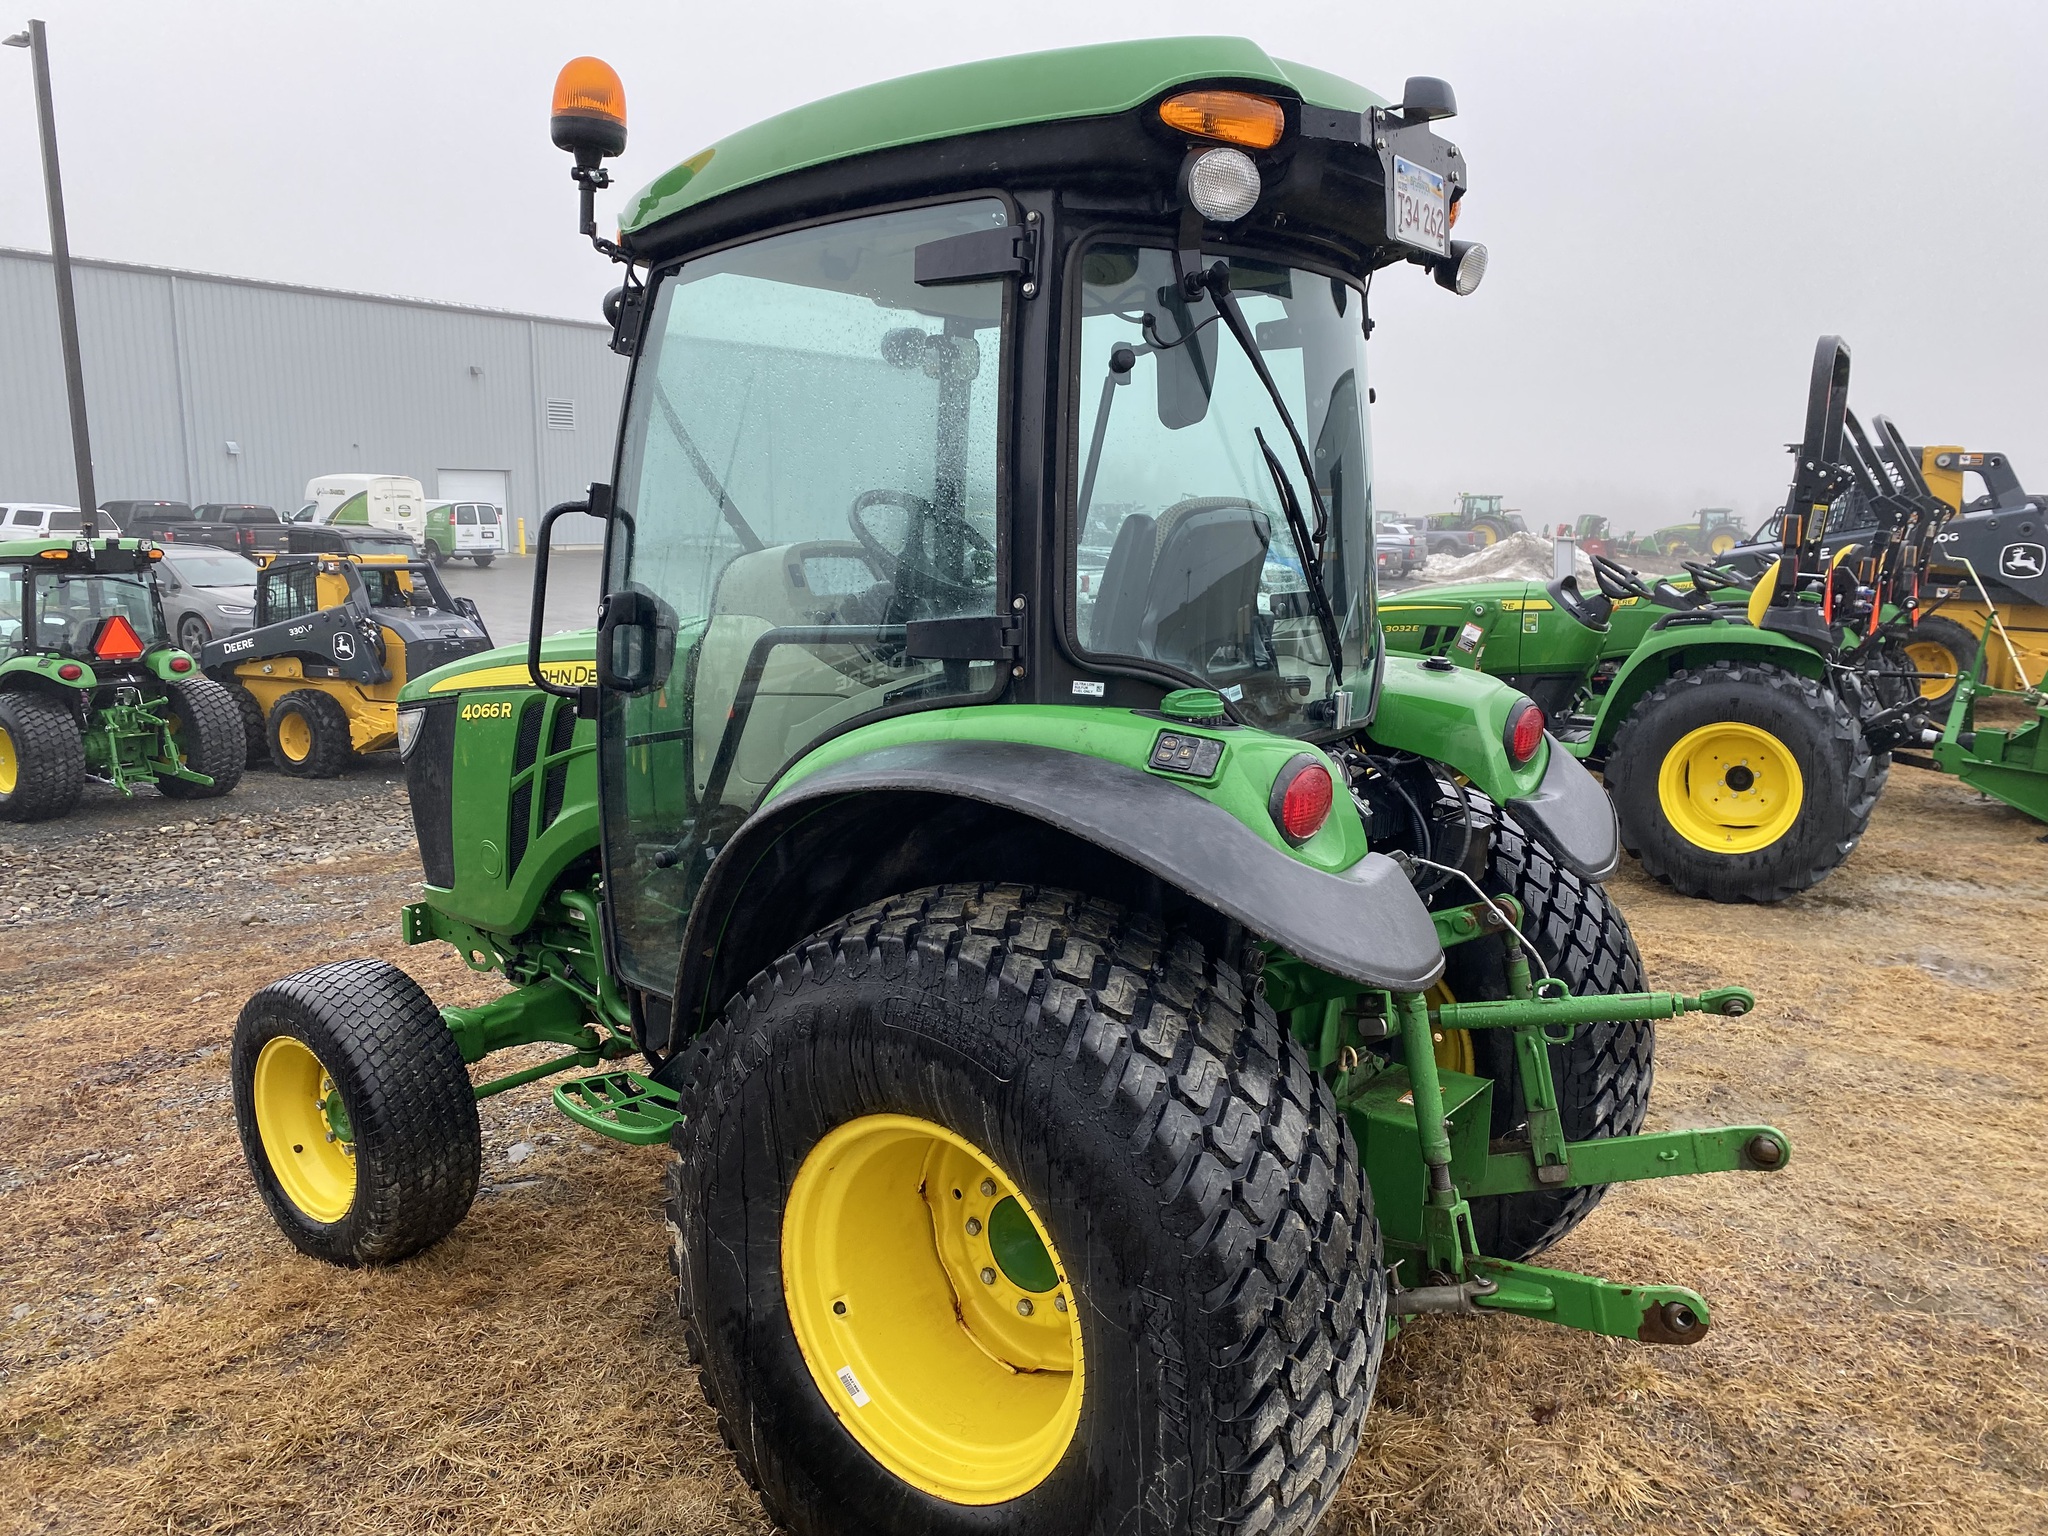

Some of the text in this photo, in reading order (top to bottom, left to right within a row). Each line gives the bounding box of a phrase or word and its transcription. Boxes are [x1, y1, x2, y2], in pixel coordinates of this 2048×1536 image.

[1398, 191, 1444, 239] T34 262
[223, 638, 255, 654] DEERE
[461, 702, 513, 721] 4066R
